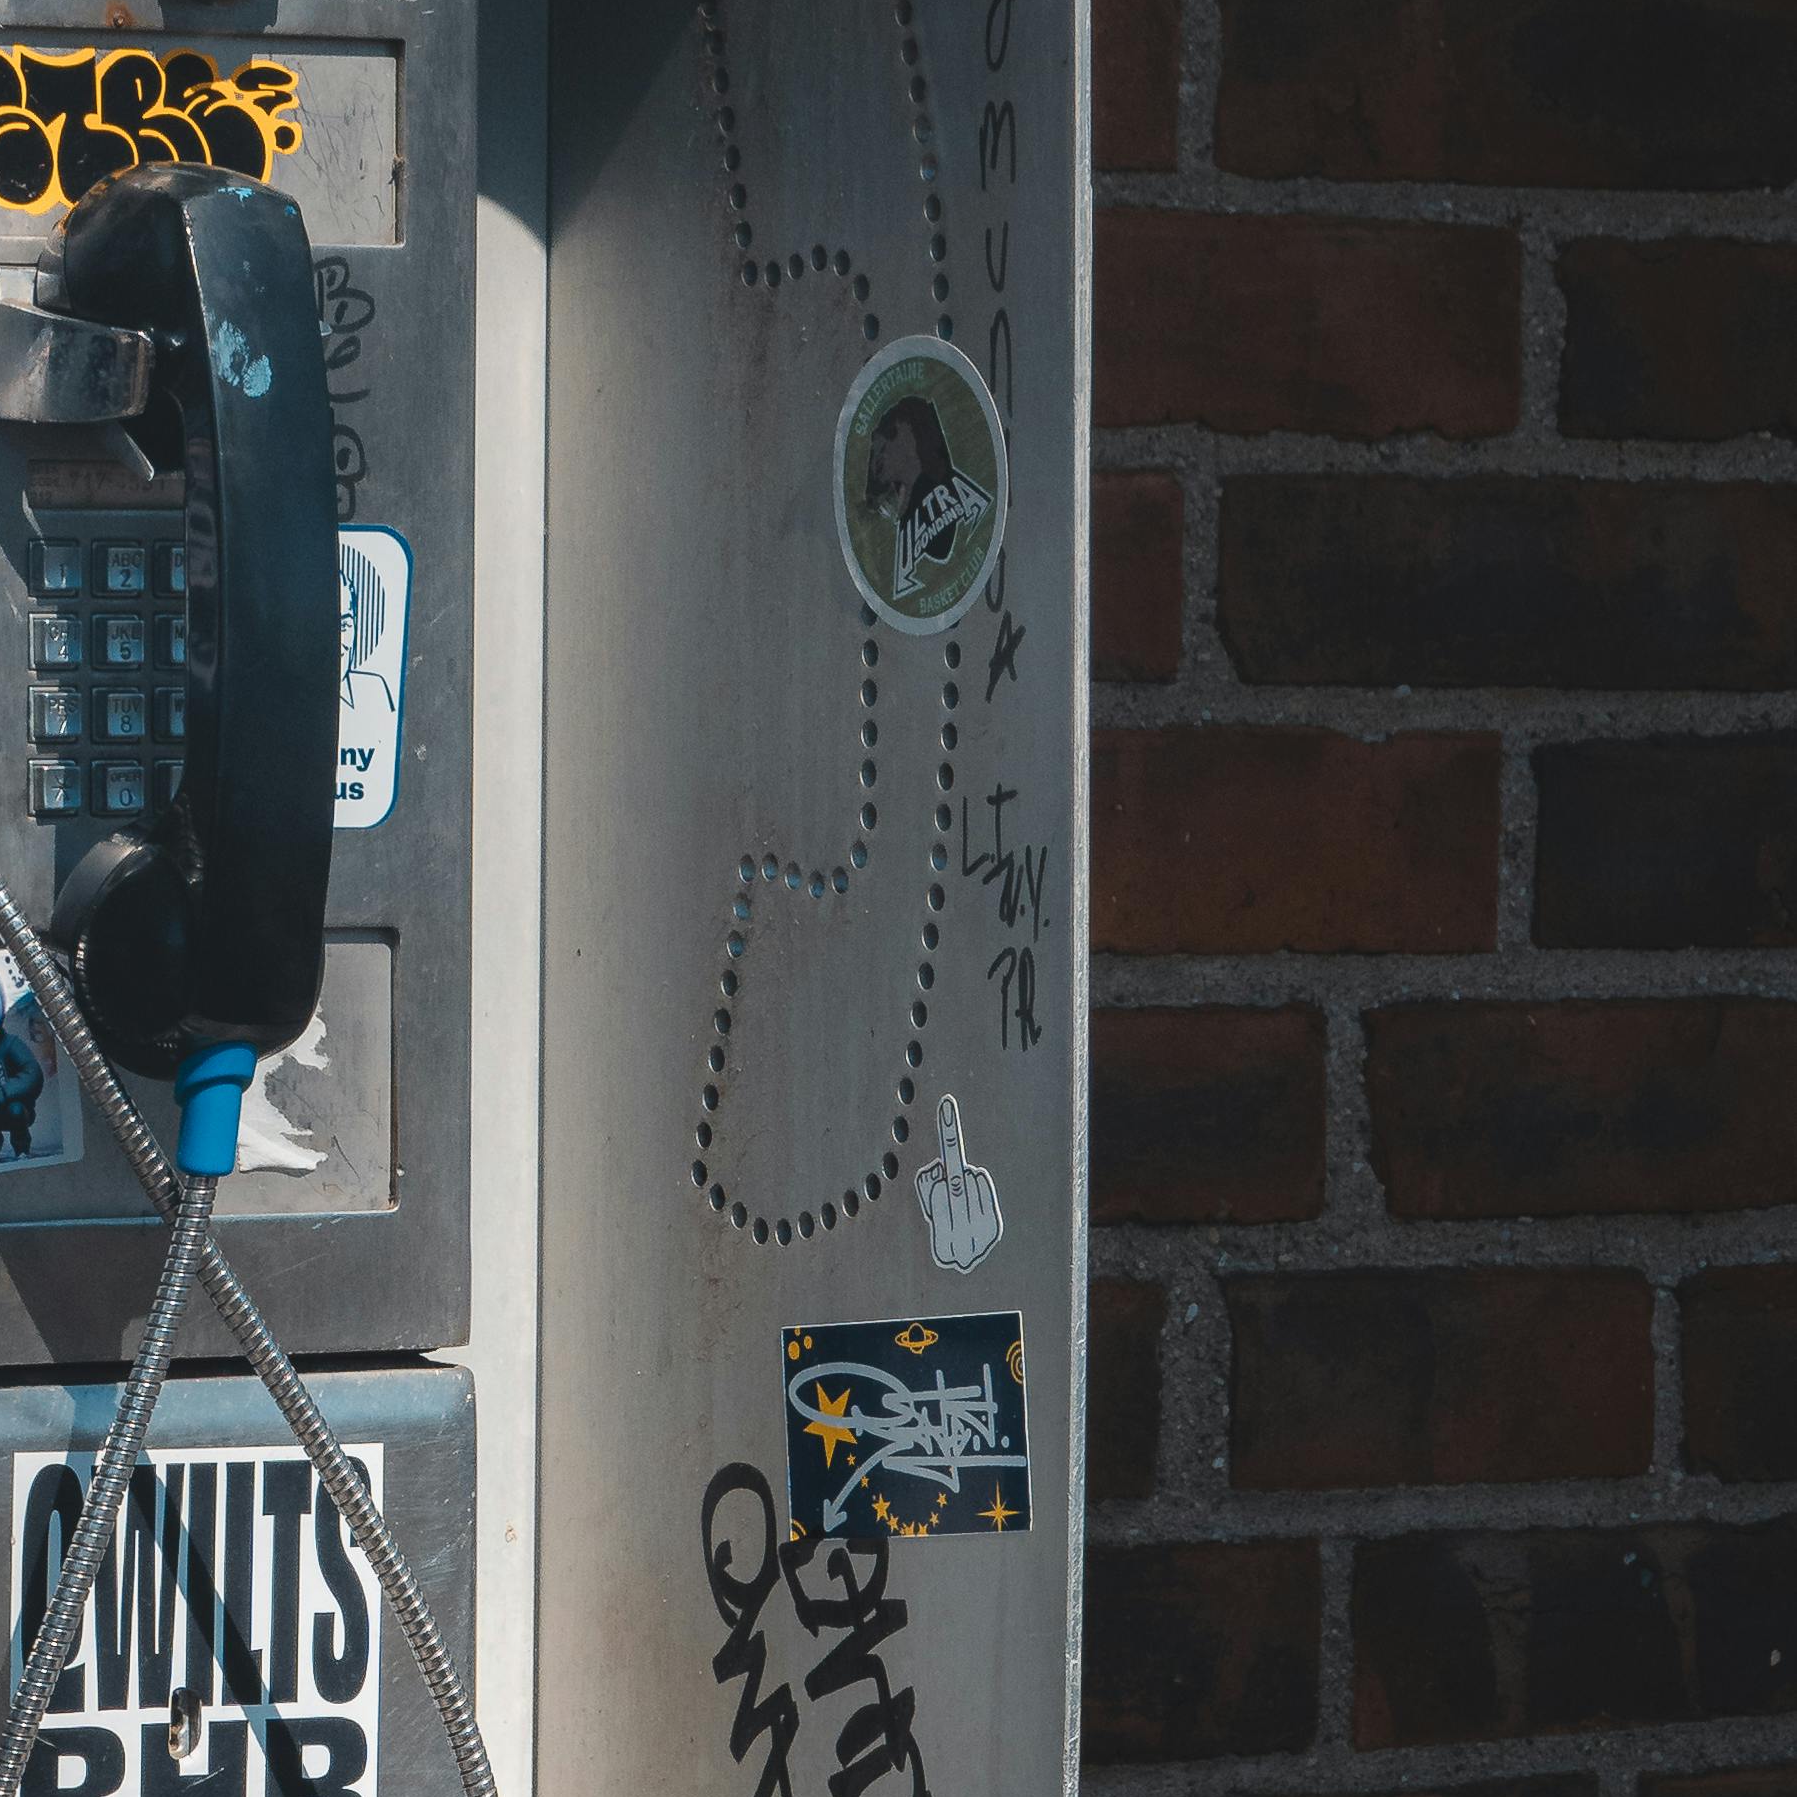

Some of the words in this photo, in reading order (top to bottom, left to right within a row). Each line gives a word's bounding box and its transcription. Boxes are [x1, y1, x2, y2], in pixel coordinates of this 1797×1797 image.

[898, 475, 991, 580] ULTRA
[119, 569, 132, 588] 2
[111, 625, 140, 640] JKL
[119, 642, 132, 661] 5
[112, 697, 141, 714] TUV
[120, 714, 132, 734] 8
[340, 747, 376, 772] ny
